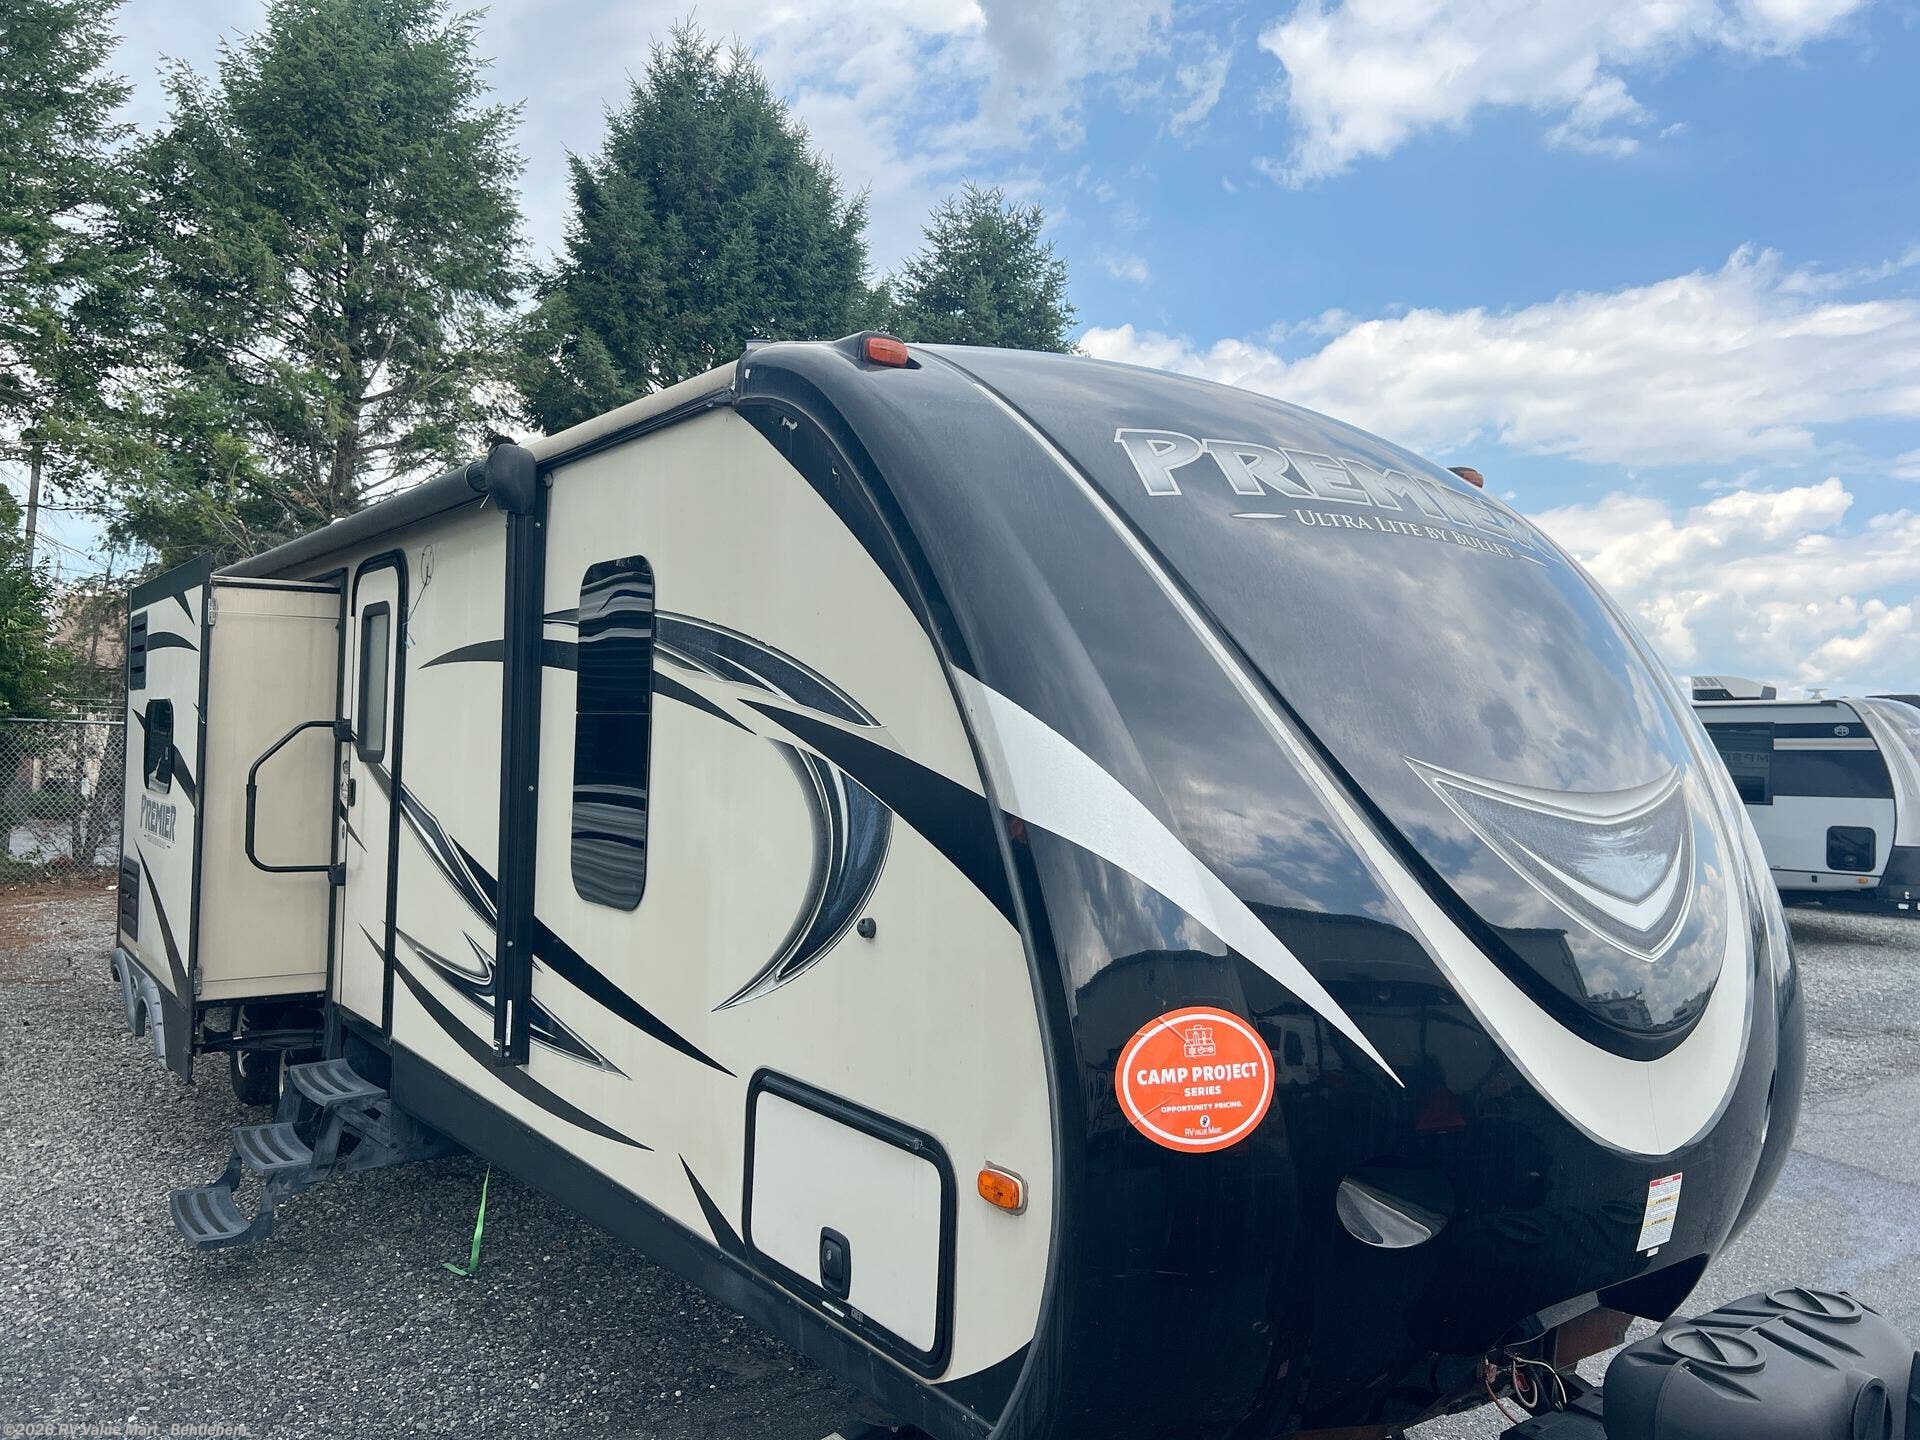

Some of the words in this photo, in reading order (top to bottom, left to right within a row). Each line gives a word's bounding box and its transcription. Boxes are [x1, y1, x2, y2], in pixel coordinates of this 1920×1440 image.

[1114, 427, 1558, 561] PREMIER
[1293, 509, 1374, 531] ULTRA
[1374, 516, 1423, 537] LITE
[1450, 530, 1515, 559] BULLET
[139, 793, 177, 842] PREMIER
[1136, 1067, 1188, 1085] CAMP
[1192, 1062, 1258, 1082] PROJECT
[1184, 1085, 1222, 1097] SERIES
[1160, 1101, 1213, 1113] OPPORTUNITY
